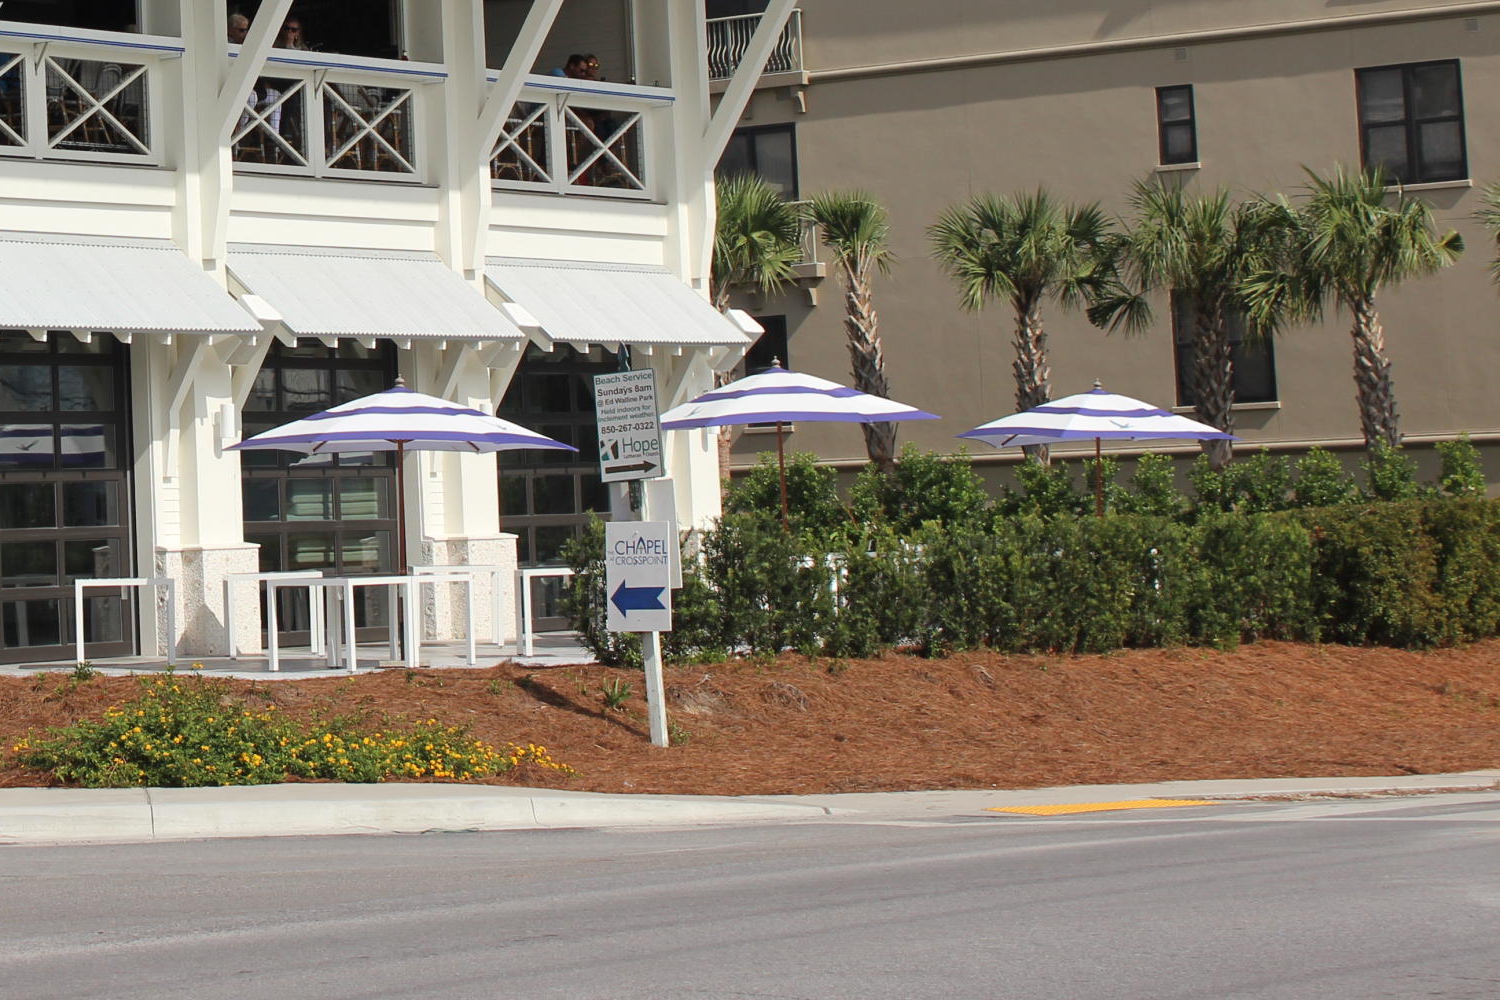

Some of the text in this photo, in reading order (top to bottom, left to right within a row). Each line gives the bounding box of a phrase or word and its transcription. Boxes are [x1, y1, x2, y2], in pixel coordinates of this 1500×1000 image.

[595, 373, 652, 385] Beach Service
[597, 384, 652, 397] Sundays 8am
[601, 422, 654, 434] 850-267-0322
[622, 437, 659, 455] Hope
[615, 536, 667, 555] CHAPEL
[615, 556, 668, 565] CROSSPOINT
